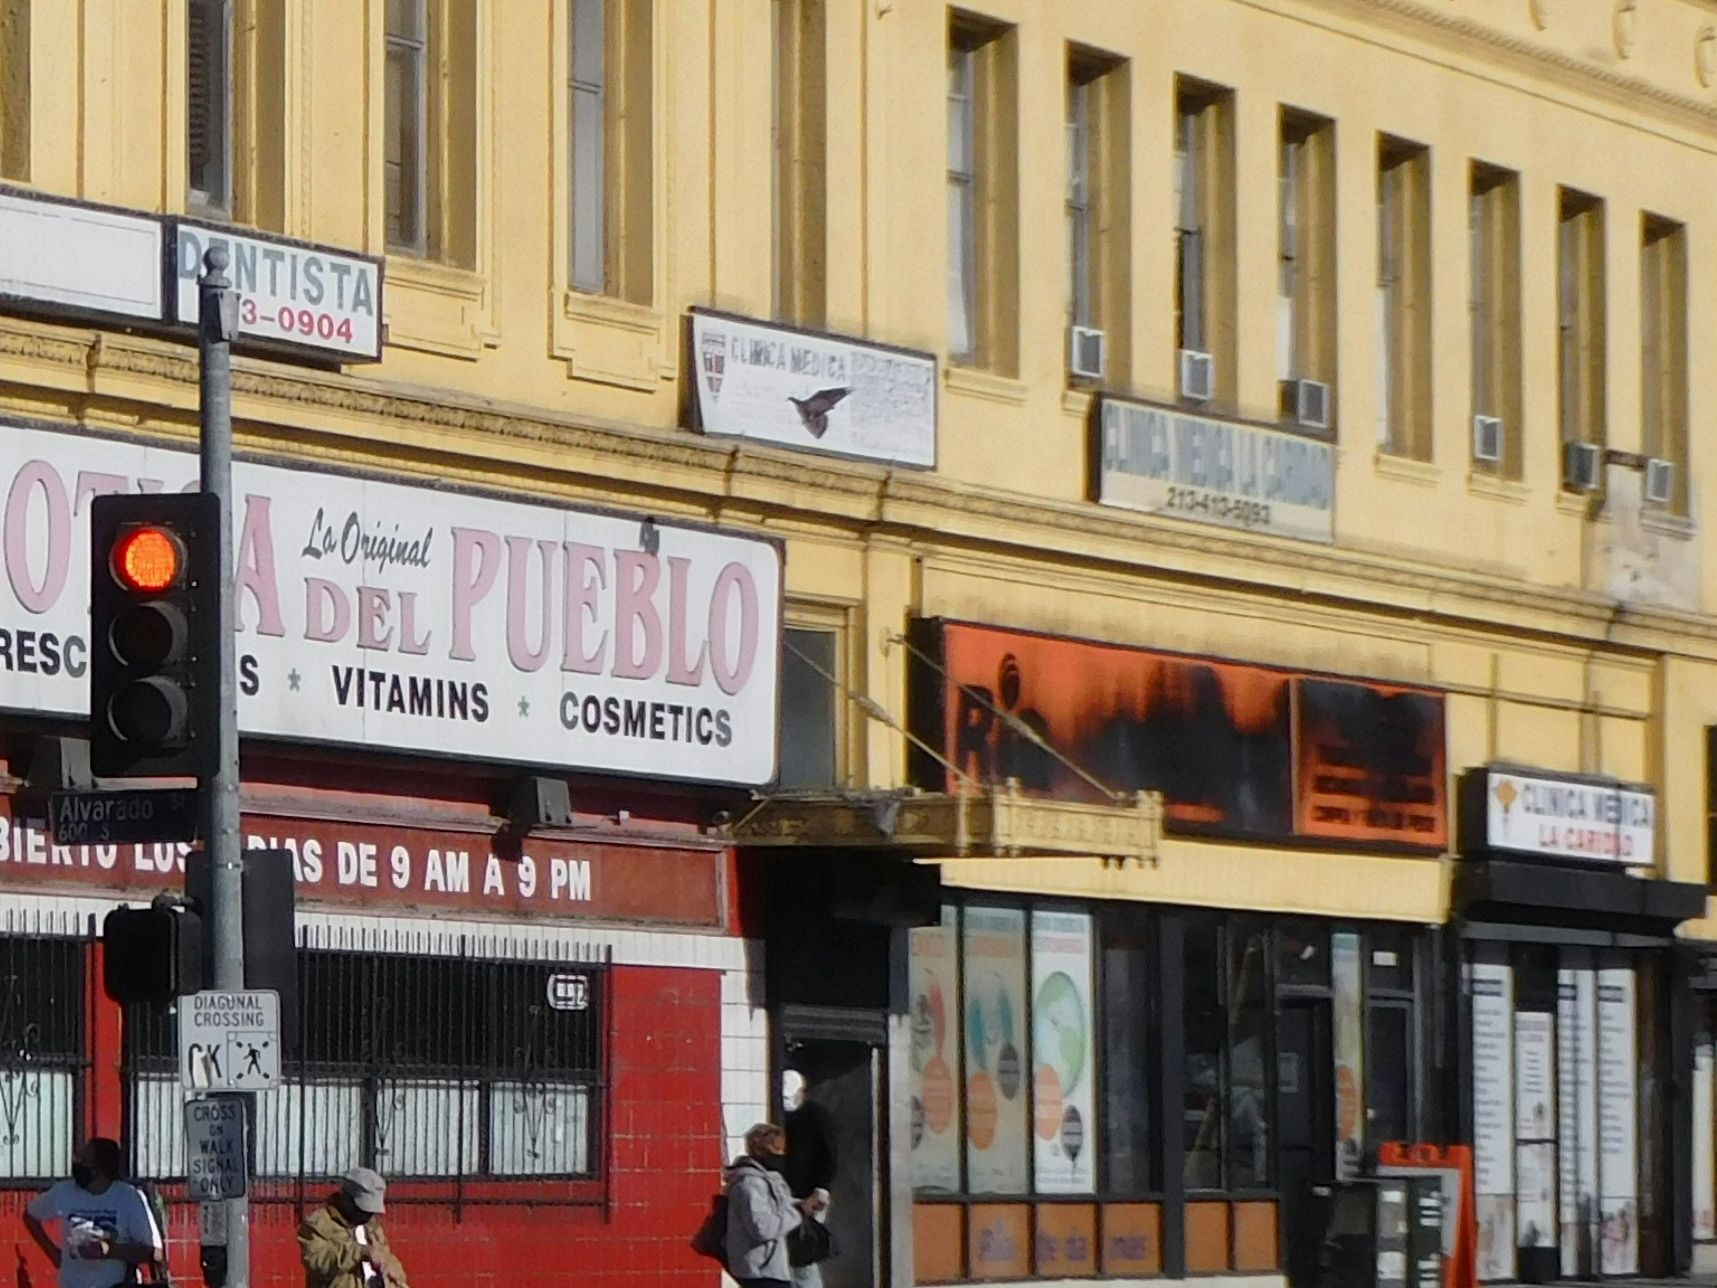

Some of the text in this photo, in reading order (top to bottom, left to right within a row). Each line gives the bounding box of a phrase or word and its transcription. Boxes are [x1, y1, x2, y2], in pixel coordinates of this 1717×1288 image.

[178, 231, 373, 316] DNTISTA
[242, 298, 353, 344] 3-0904
[340, 511, 434, 575] Original
[303, 576, 433, 655] DEL
[448, 525, 760, 696] PUEBLO
[332, 664, 733, 748] VITAMINS COSMETICS
[58, 795, 154, 822] Alvarado
[338, 841, 378, 889] DE
[391, 843, 411, 890] 9
[425, 848, 470, 894] AM
[484, 855, 505, 896] A
[519, 857, 536, 899] 9
[551, 858, 592, 902] PM
[193, 994, 263, 1011] DIAGONAL
[193, 1011, 265, 1027] CROSSING
[193, 1105, 237, 1123] CROSS
[199, 1139, 234, 1155] WALK
[192, 1158, 239, 1175] SIGNAL
[199, 1176, 234, 1194] ONLY
